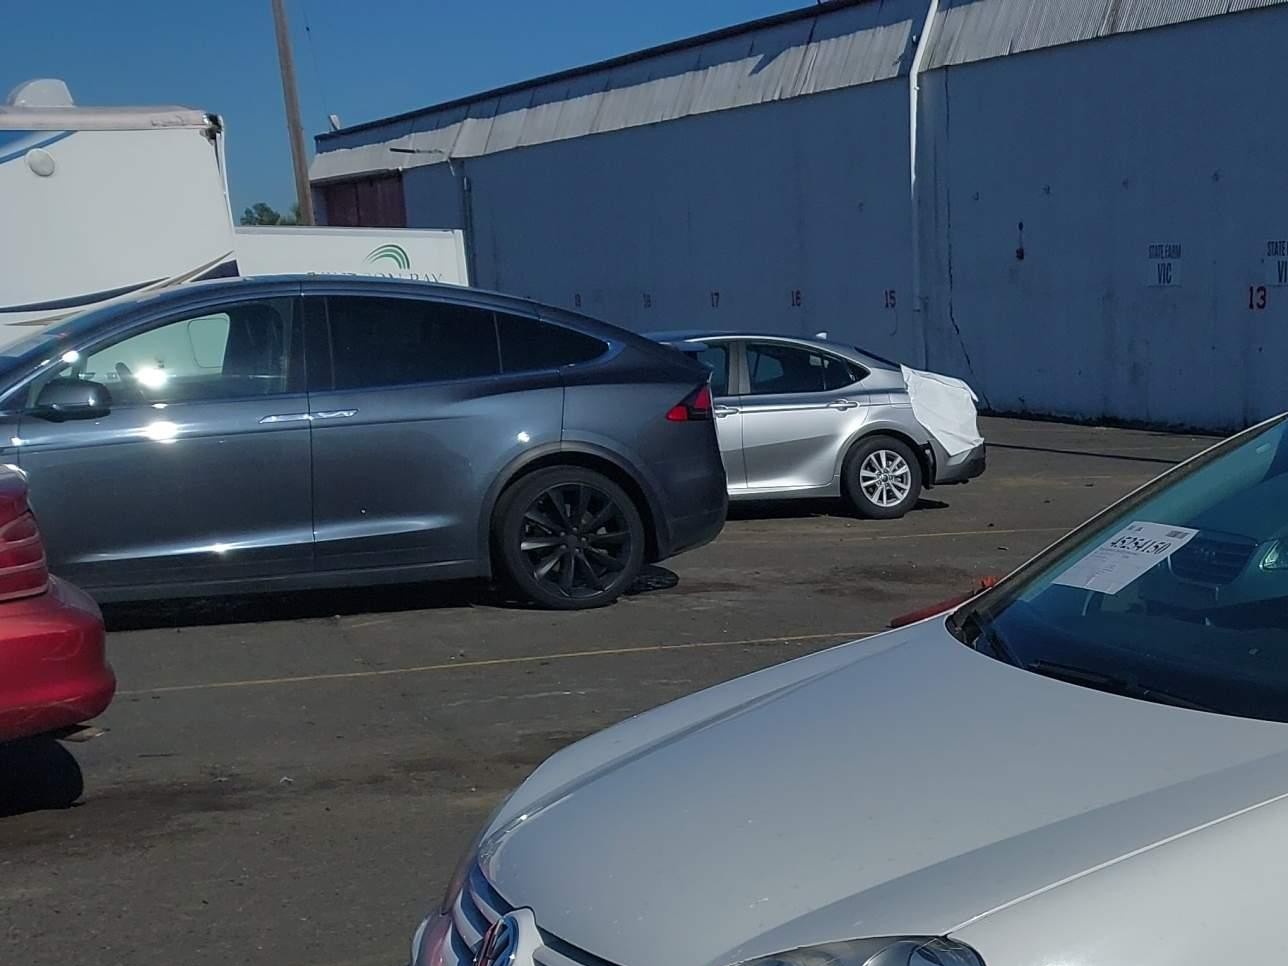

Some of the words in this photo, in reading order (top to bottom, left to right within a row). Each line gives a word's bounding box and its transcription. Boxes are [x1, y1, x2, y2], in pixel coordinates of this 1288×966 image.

[1148, 244, 1165, 259] STATE
[1165, 243, 1182, 259] FARM
[1266, 240, 1286, 256] STATE
[1157, 262, 1172, 284] VIC
[711, 291, 720, 308] 17
[791, 289, 801, 307] 16
[884, 289, 897, 308] 15
[1249, 285, 1267, 310] 13
